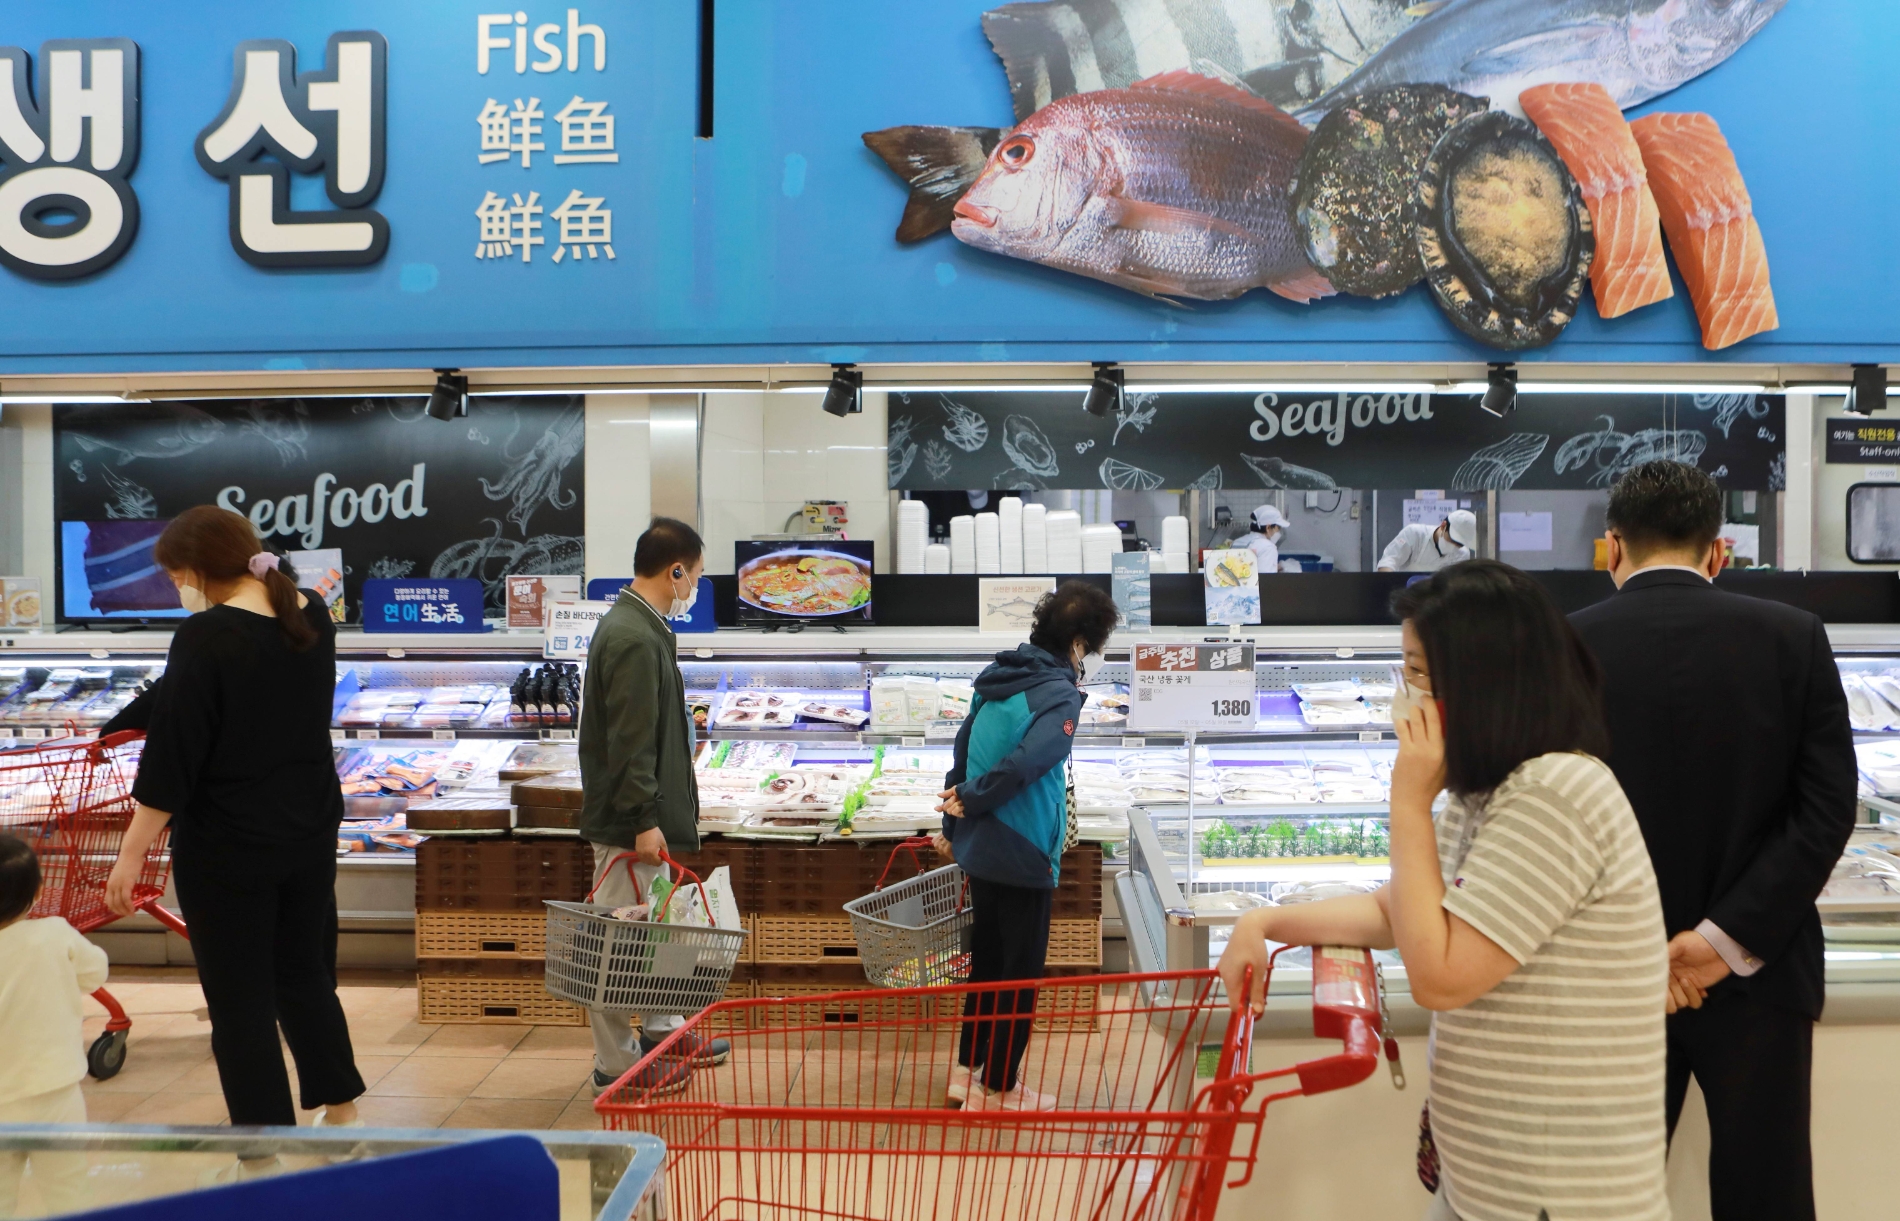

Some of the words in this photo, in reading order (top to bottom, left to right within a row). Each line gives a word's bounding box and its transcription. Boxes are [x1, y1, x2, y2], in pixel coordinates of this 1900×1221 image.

[477, 8, 606, 75] Fish
[476, 95, 619, 169] 鲜鱼
[474, 188, 616, 264] 鮮魚
[1250, 392, 1434, 446] Seafood
[1860, 445, 1900, 459] Staff-onl
[217, 462, 428, 550] Seafood
[555, 610, 571, 620] 손질
[1160, 646, 1196, 671] 추천
[1209, 645, 1243, 670] 상품
[1139, 675, 1154, 684] 국산
[1157, 675, 1173, 684] 냉동
[1175, 675, 1191, 684] 꽃게
[1211, 700, 1251, 717] 1,380
